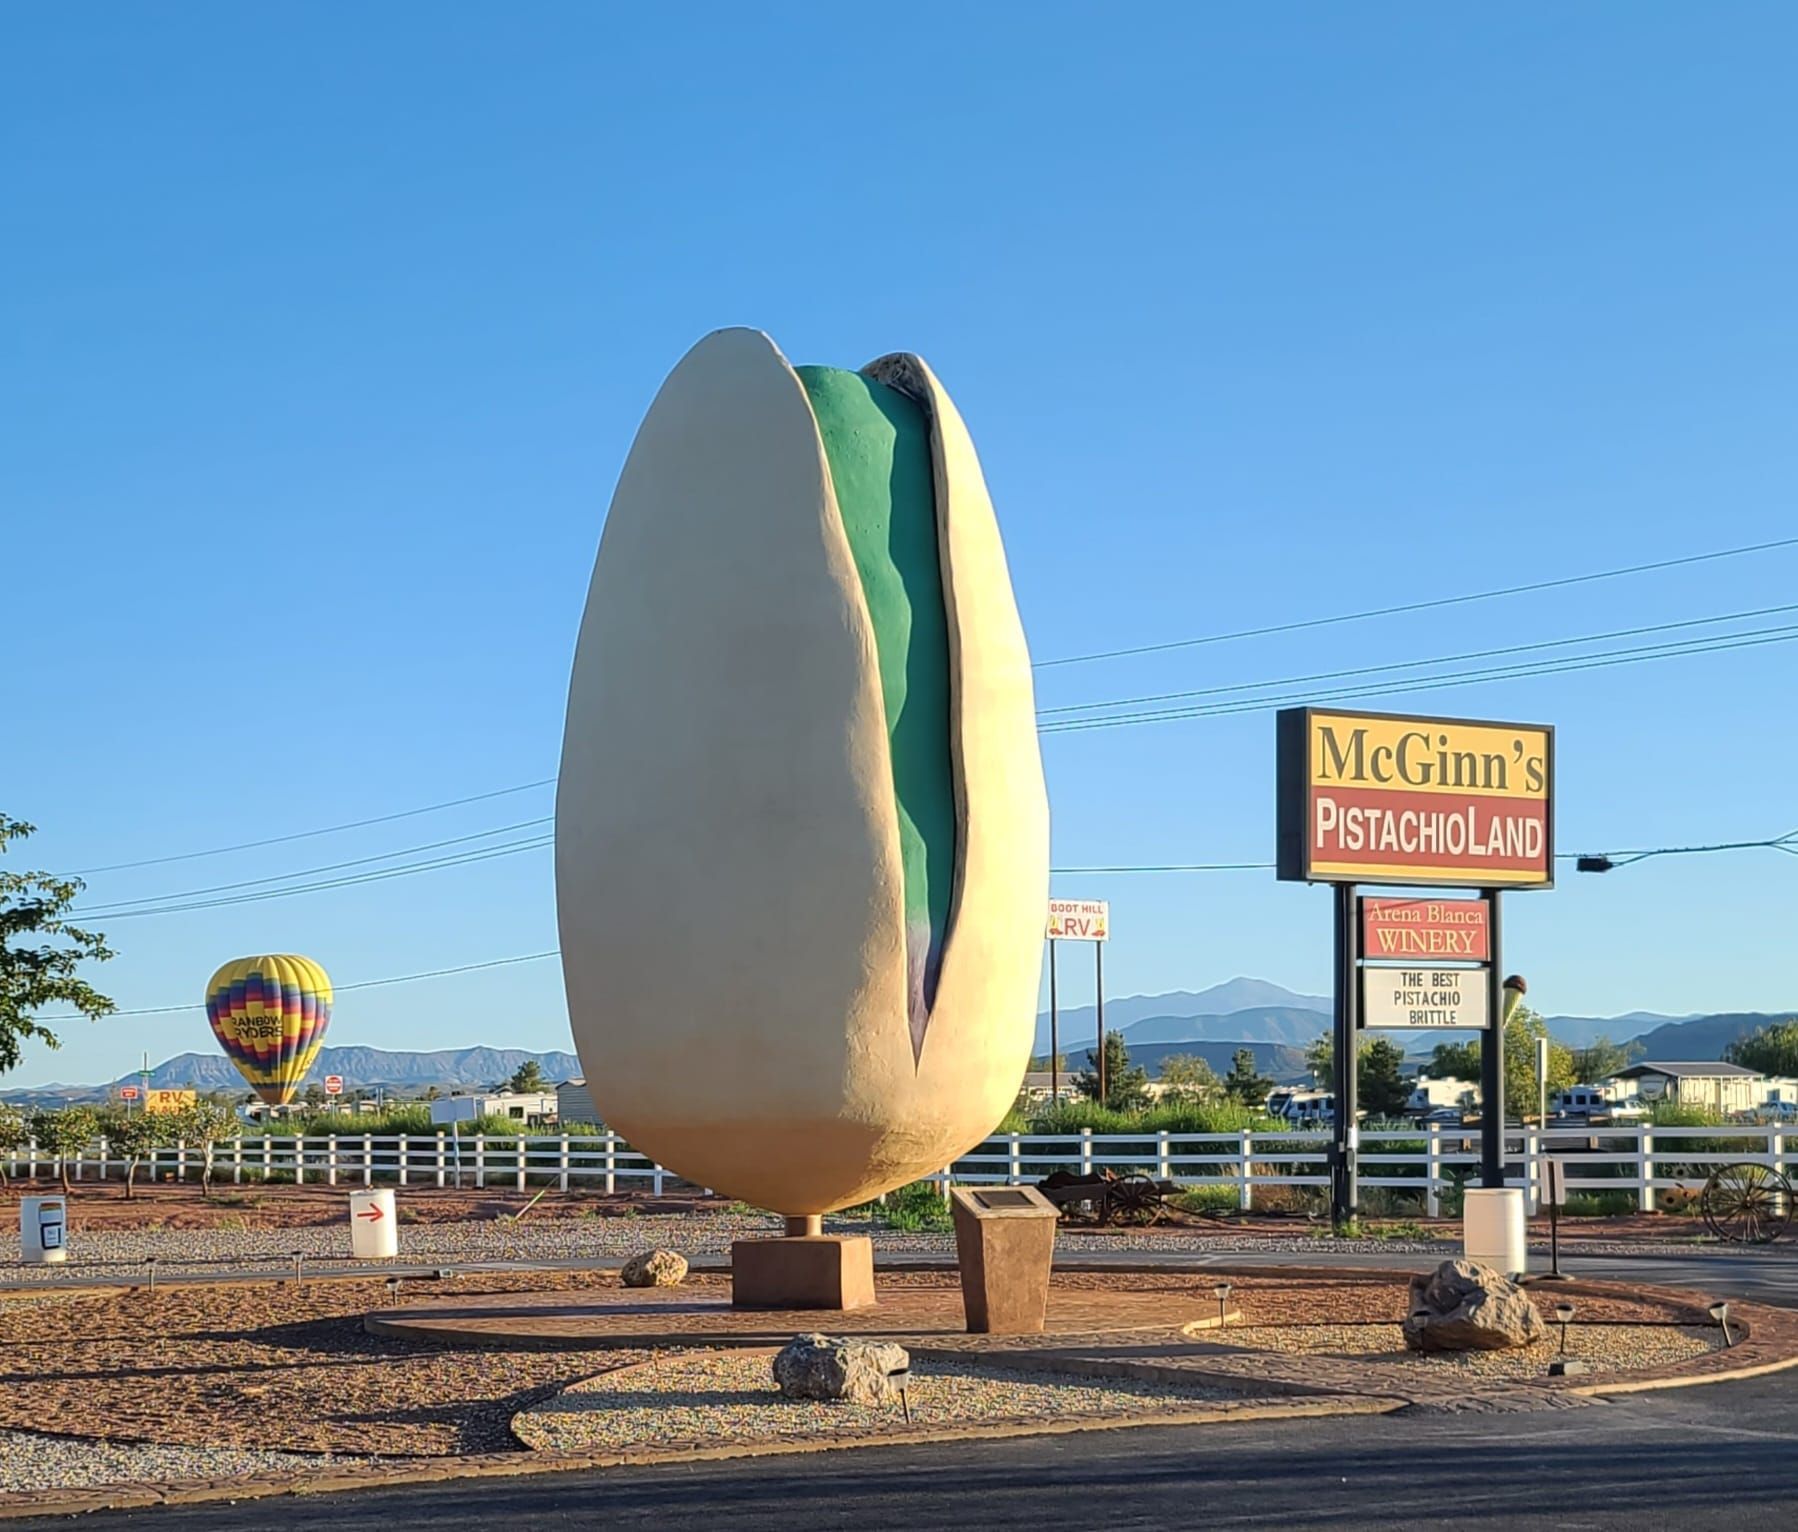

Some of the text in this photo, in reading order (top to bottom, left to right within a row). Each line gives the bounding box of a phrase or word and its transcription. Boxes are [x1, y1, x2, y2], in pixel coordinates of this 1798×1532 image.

[1317, 726, 1544, 793] McGinn's
[1051, 903, 1104, 914] BOOT HILL
[1369, 903, 1484, 924] Arena Blanca
[1064, 918, 1091, 936] RV
[1376, 928, 1478, 954] WINERY
[1400, 972, 1460, 987] THE BEST
[1394, 990, 1461, 1006] PISTACHIO
[1409, 1010, 1457, 1025] BRITTLE
[159, 1091, 183, 1103] RV
